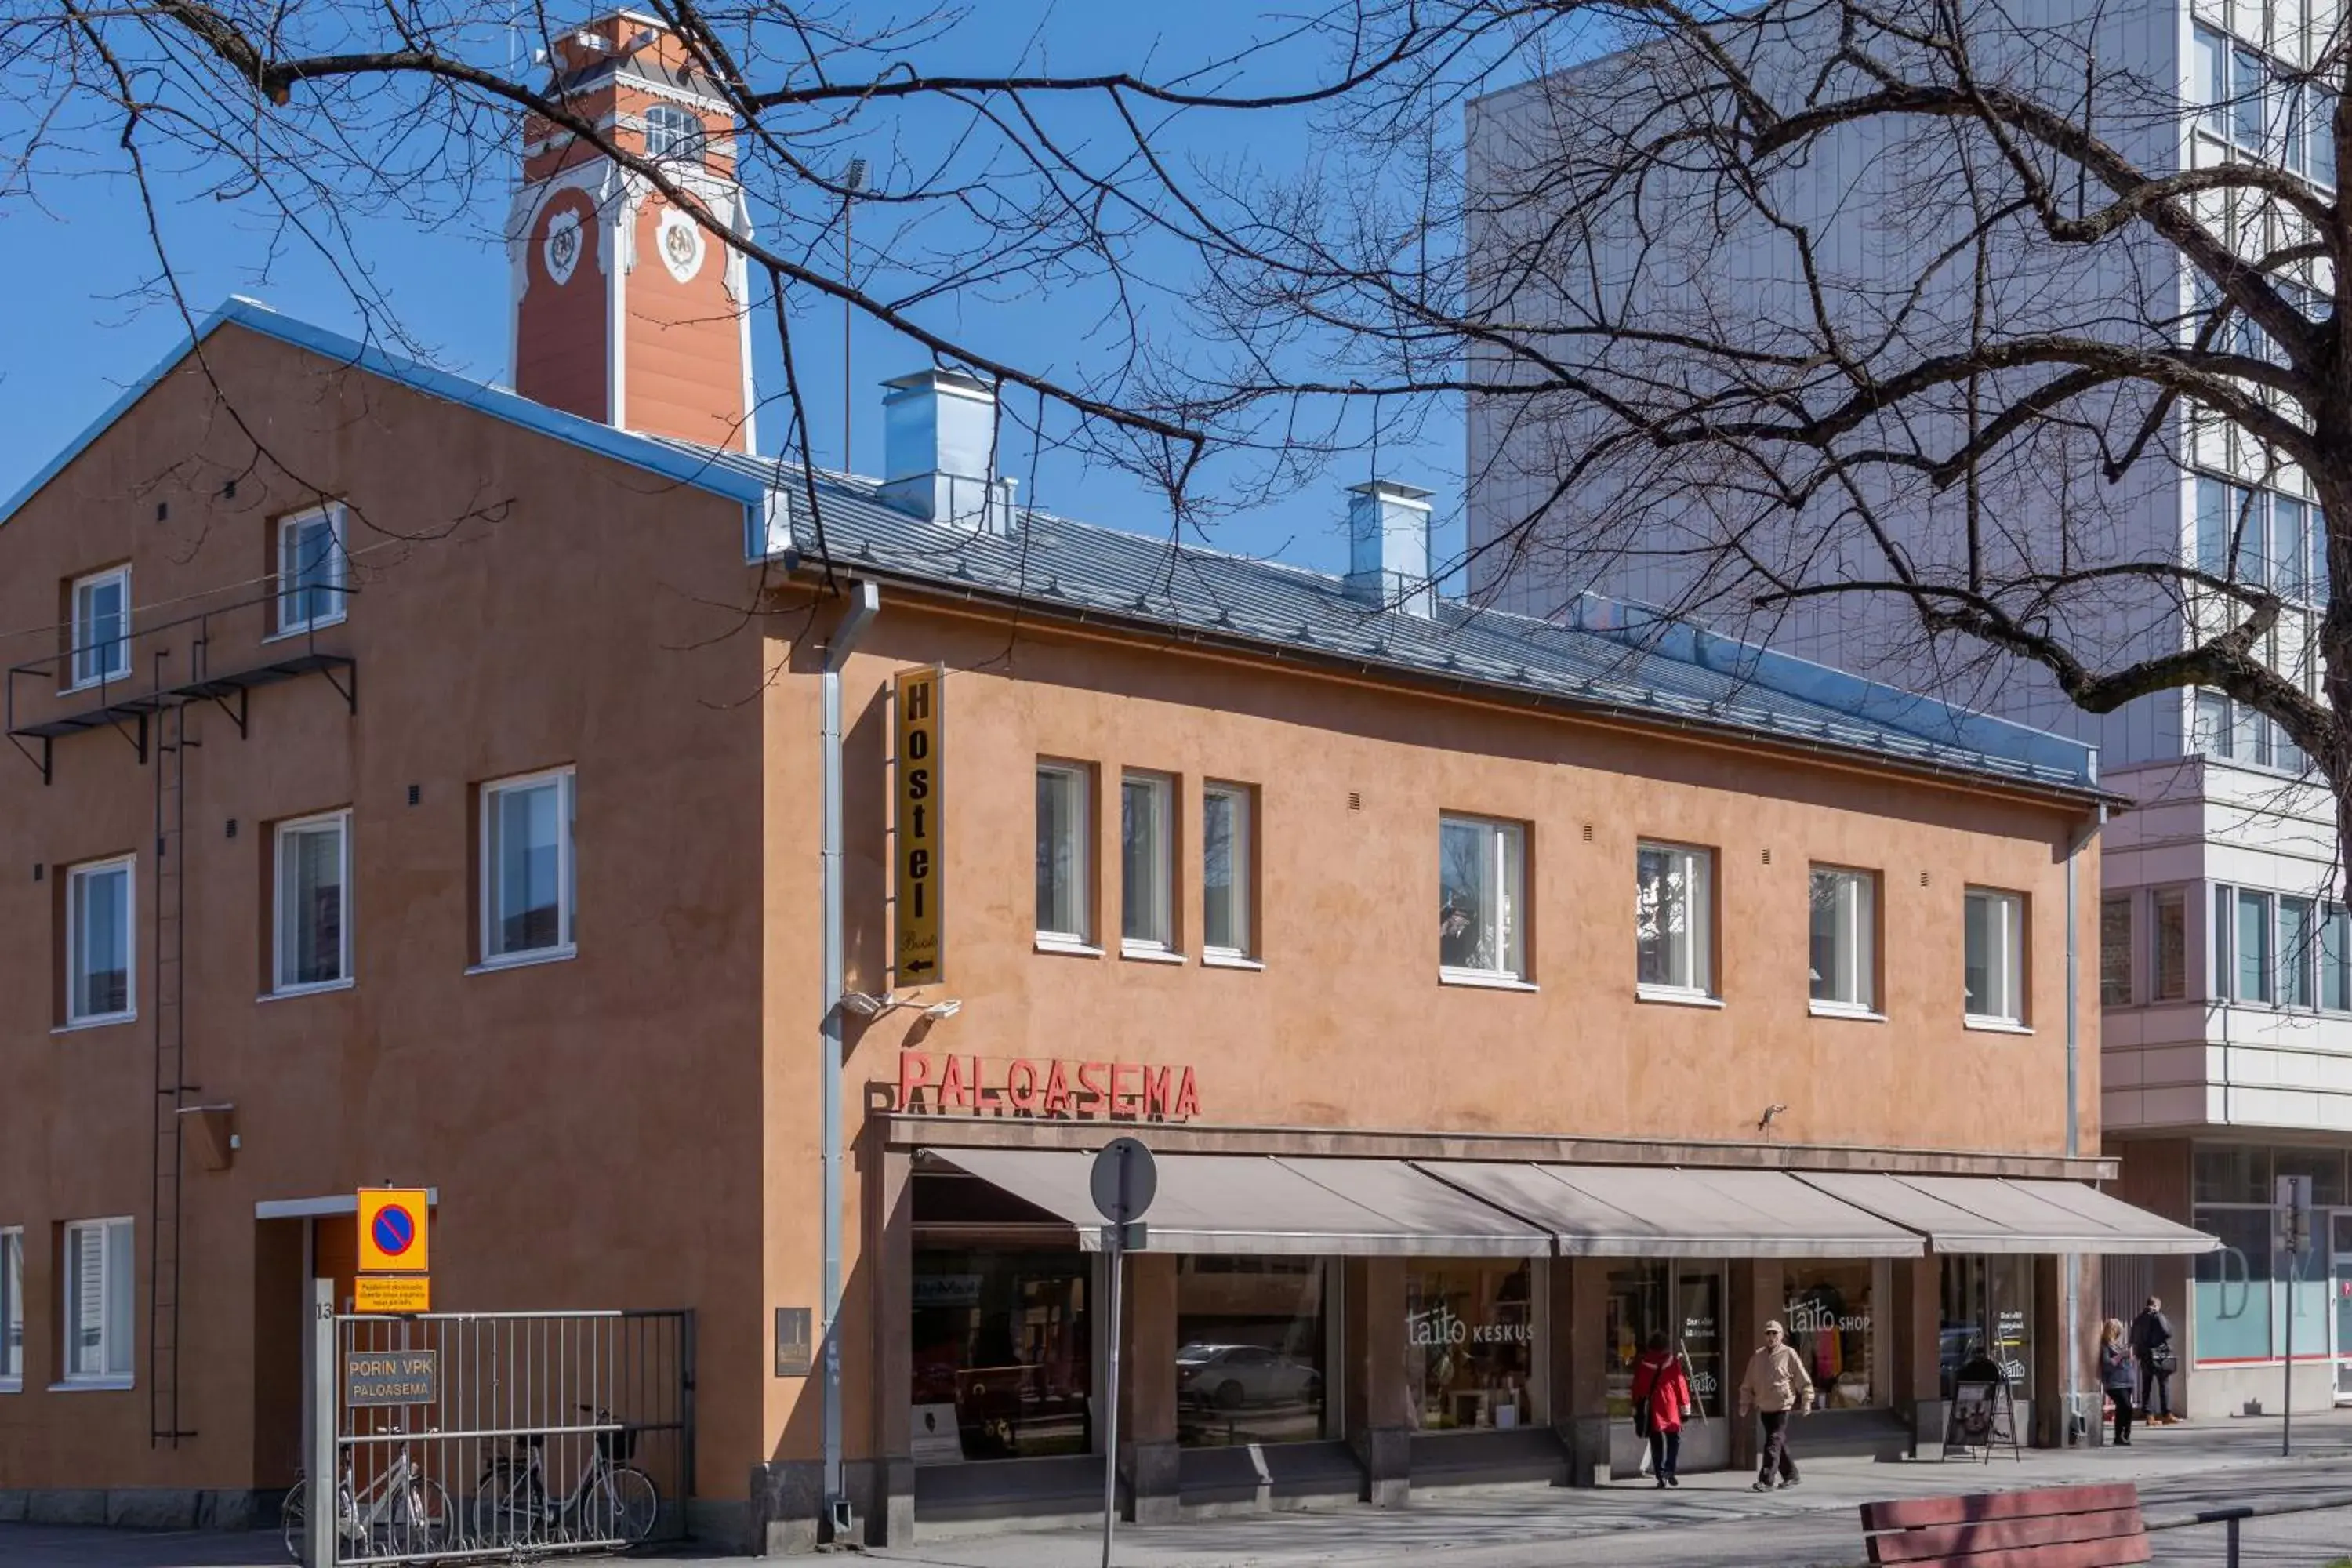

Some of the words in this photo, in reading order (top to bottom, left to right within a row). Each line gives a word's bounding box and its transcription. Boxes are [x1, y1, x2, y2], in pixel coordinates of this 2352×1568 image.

[907, 682, 930, 919] Hostel
[899, 1051, 1201, 1118] PALOASEMA
[316, 1303, 332, 1319] 13
[1405, 1305, 1466, 1345] taito
[1472, 1323, 1534, 1344] KESKUS
[1782, 1298, 1835, 1333] taito
[1838, 1316, 1871, 1331] SHOP
[349, 1359, 397, 1377] PORIN
[402, 1358, 432, 1375] VPK
[354, 1381, 429, 1398] PALOASEMA
